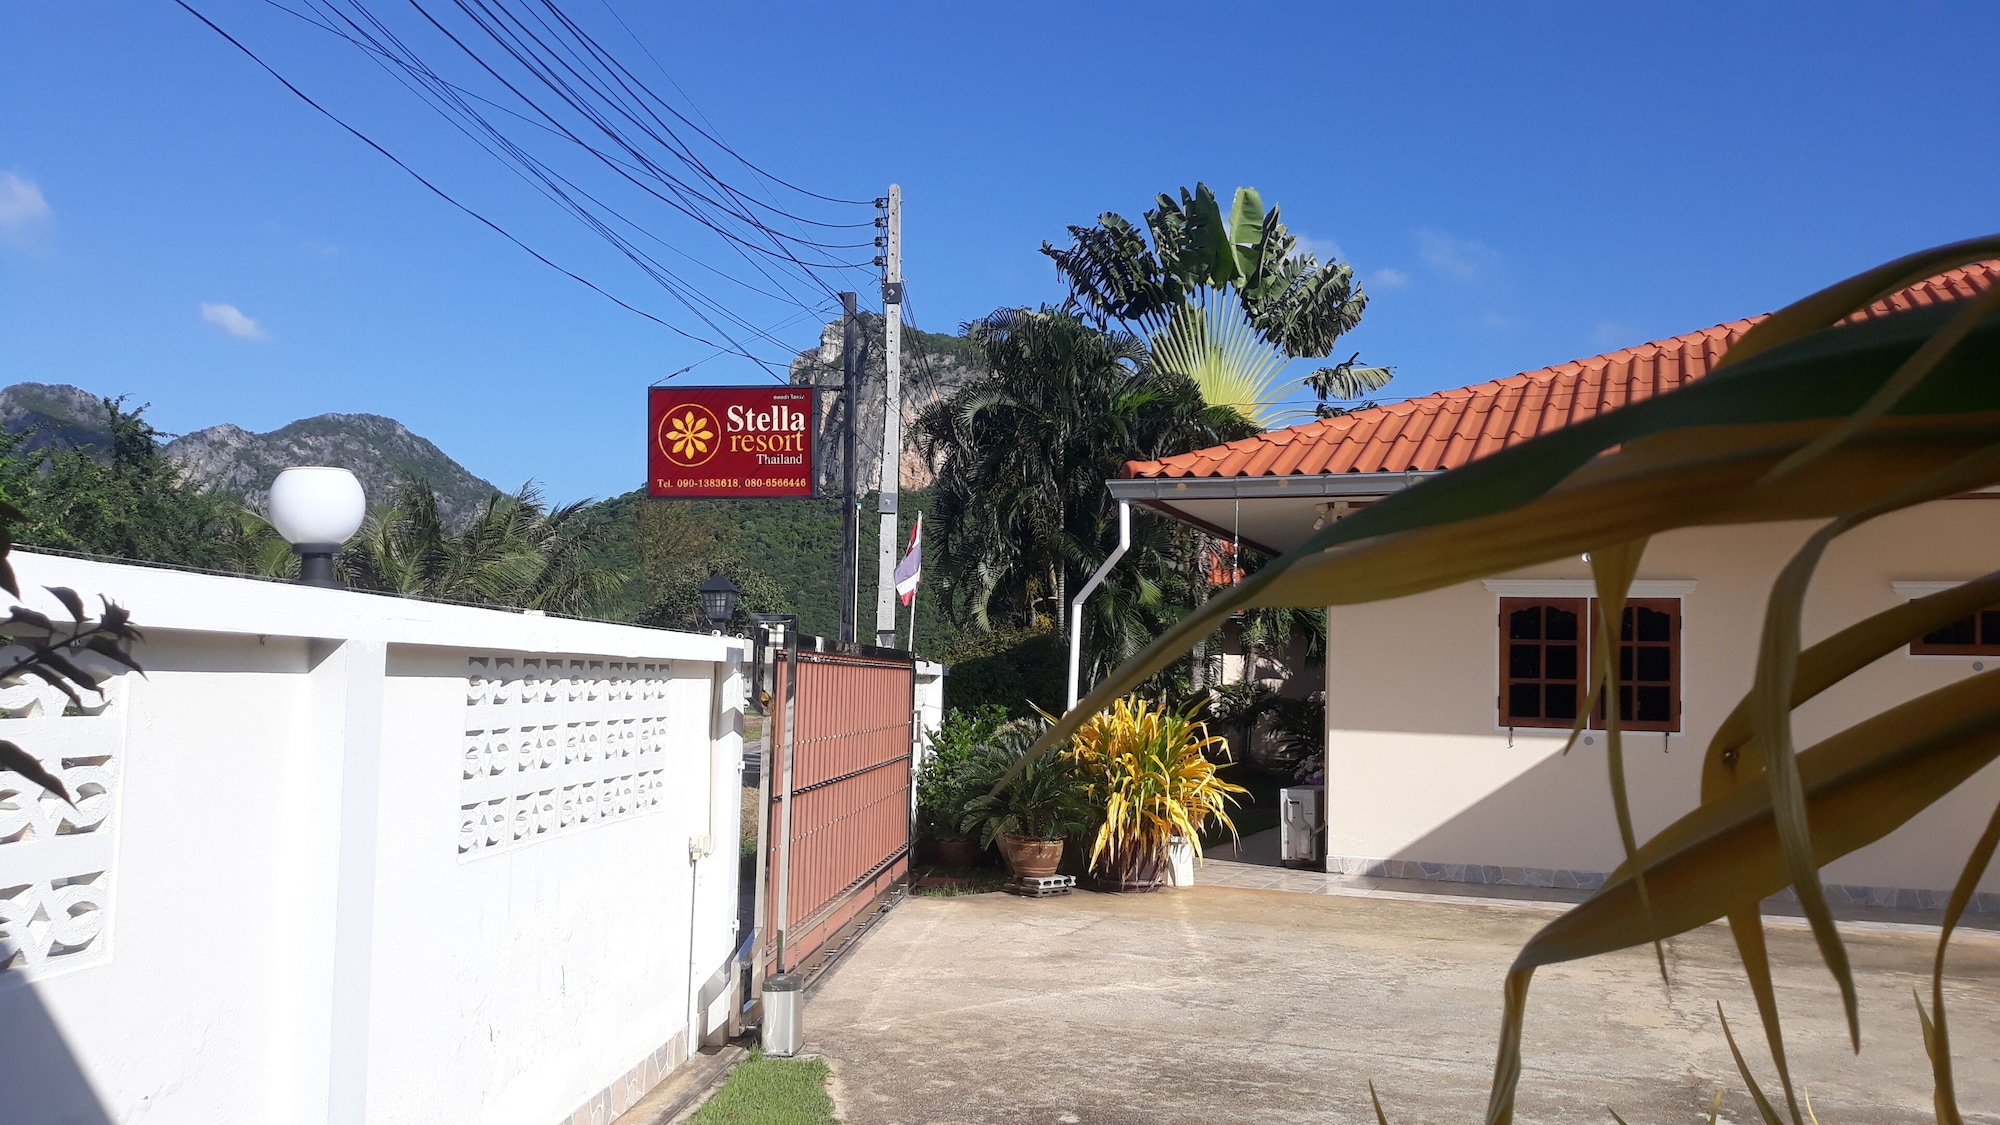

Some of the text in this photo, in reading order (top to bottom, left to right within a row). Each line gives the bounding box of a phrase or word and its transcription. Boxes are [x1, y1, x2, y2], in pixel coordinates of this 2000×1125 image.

[726, 404, 806, 432] Stella
[729, 431, 804, 452] resort
[756, 453, 803, 465] Thailand
[656, 478, 674, 488] Tel.
